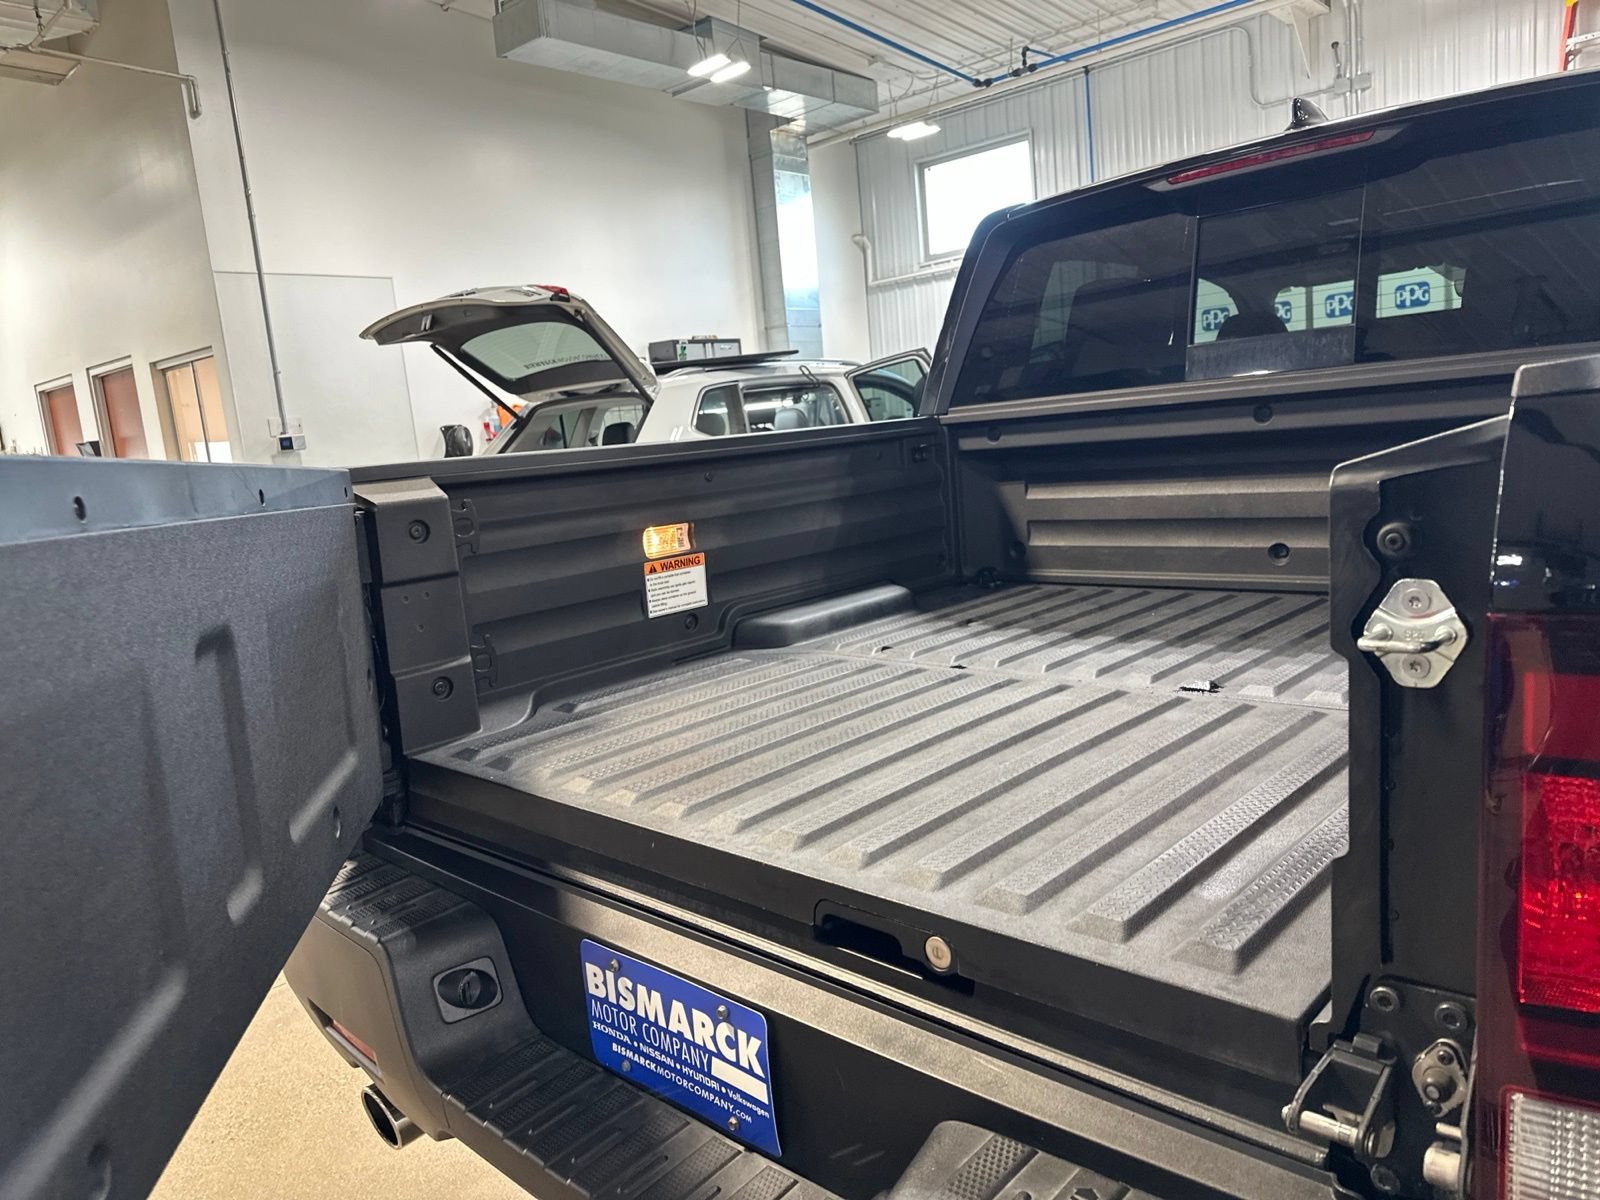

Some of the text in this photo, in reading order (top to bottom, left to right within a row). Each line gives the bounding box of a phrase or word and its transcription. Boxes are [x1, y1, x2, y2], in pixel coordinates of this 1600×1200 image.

[1396, 284, 1430, 307] PPG
[660, 556, 701, 572] WARNING
[585, 962, 766, 1079] BISMARCK
[591, 999, 709, 1072] MOTOR COMPANY
[592, 1021, 770, 1119] HONDA NISSAN HYUNDAI Volkswagen
